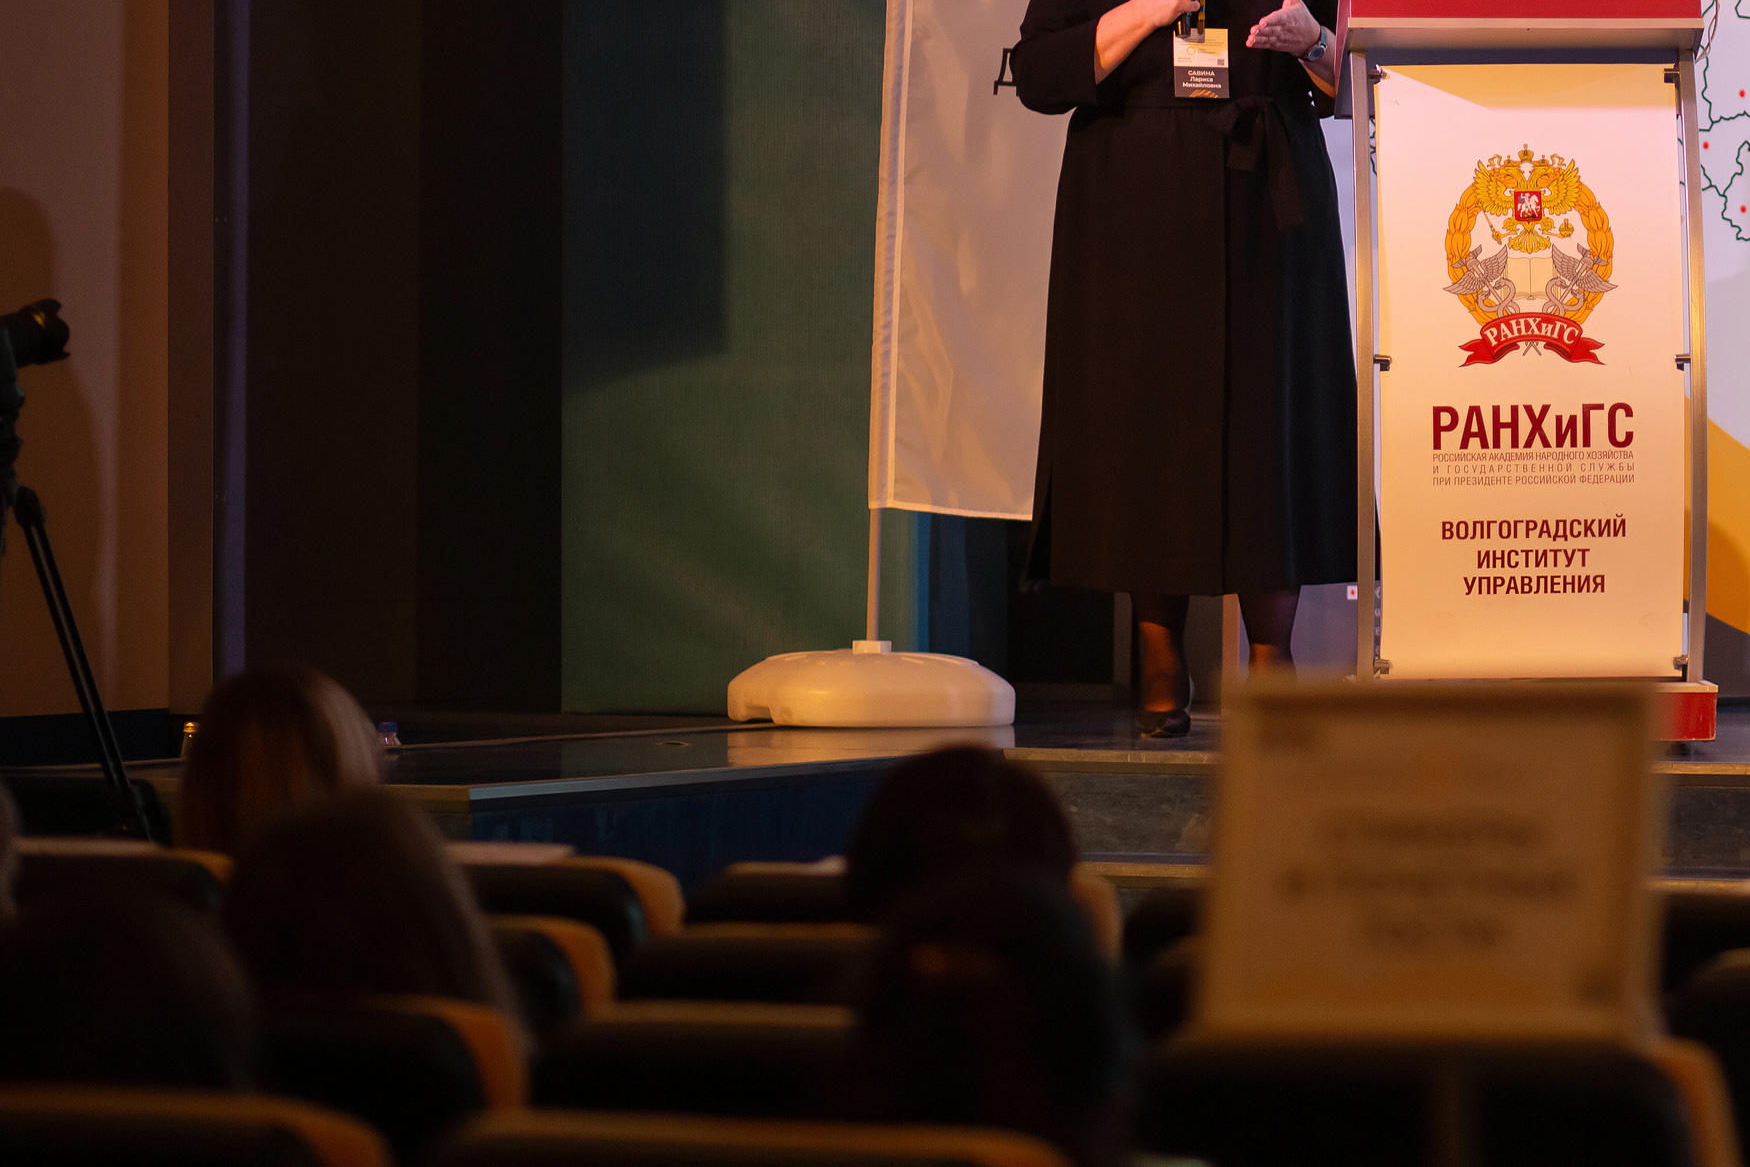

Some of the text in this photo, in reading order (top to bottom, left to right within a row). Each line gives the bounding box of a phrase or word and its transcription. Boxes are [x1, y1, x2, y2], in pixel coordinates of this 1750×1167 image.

[1483, 317, 1580, 347] РАНХиГС
[1432, 402, 1634, 451] РАНХиГС
[1432, 449, 1634, 463] РОССИЙСКАЯ АКАДЕМИЯ НАРОДНОГО ХОЗЯЙСТВА
[1432, 462, 1635, 474] И ГОСУДАРСТВЕННОЙ СЛУЖБЫ
[1432, 474, 1635, 487] ПРИ ПРЕЗИДЕНТЕ РОССИЙСКОЙ ФЕДЕРАЦИИ
[1441, 513, 1627, 542] ВОЛГОГРАДСКИЙ
[1477, 548, 1591, 569] ИНСТИТУТ
[1463, 574, 1605, 596] УПРАВЛЕНИЯ
